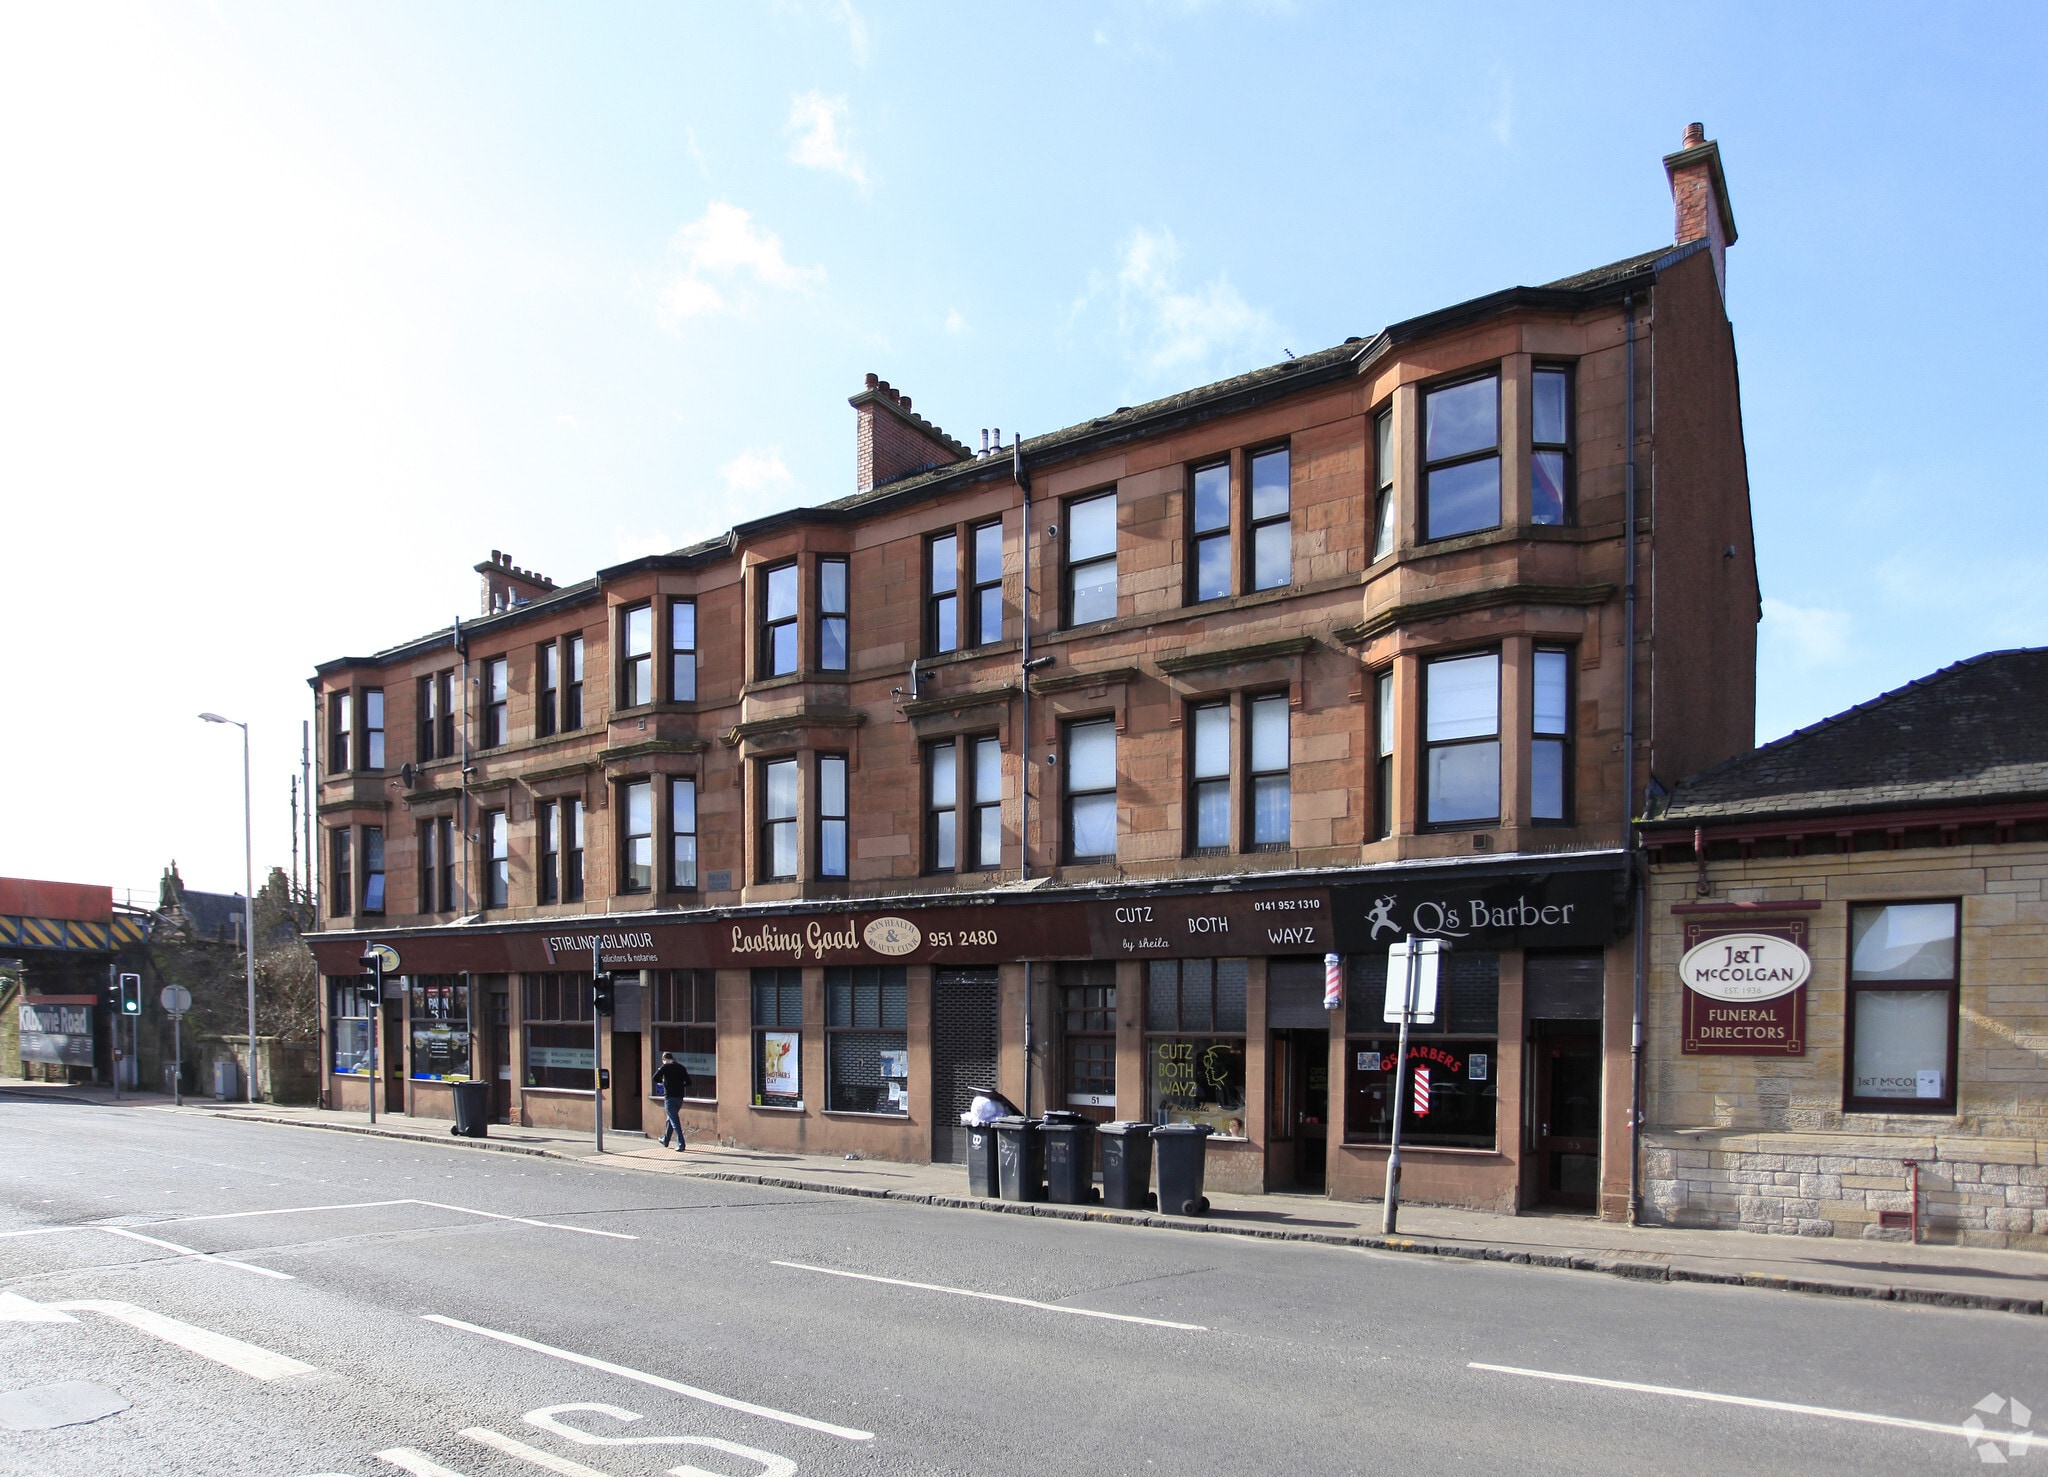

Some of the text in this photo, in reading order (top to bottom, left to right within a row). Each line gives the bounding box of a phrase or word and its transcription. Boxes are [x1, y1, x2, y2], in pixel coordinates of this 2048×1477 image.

[1254, 899, 1320, 911] 0141 952 1310
[1115, 906, 1154, 923] CUTZ
[1413, 895, 1574, 937] Q's Barber
[866, 919, 915, 935] SKIN HEALTH
[1188, 916, 1229, 933] BOTH
[731, 919, 860, 960] Looking Good
[885, 929, 900, 943] &
[928, 931, 954, 948] 951
[959, 929, 998, 946] 2480
[1267, 926, 1315, 944] WAYZ
[868, 938, 896, 953] BEAUTY
[897, 936, 919, 953] CLINIC
[1122, 937, 1170, 951] by sheila
[1723, 945, 1765, 968] J&T
[1724, 986, 1762, 995] EST. 1936
[60, 1006, 87, 1034] Road
[1708, 1009, 1777, 1022] FUNERAL
[1700, 1026, 1785, 1039] DIRECTORS
[1158, 1043, 1193, 1060] CUTZ
[1405, 1046, 1462, 1073] ARBERS
[1158, 1062, 1194, 1078] BOTH
[1158, 1081, 1197, 1097] WAYZ
[1091, 1096, 1100, 1105] 51
[1158, 1100, 1173, 1114] By
